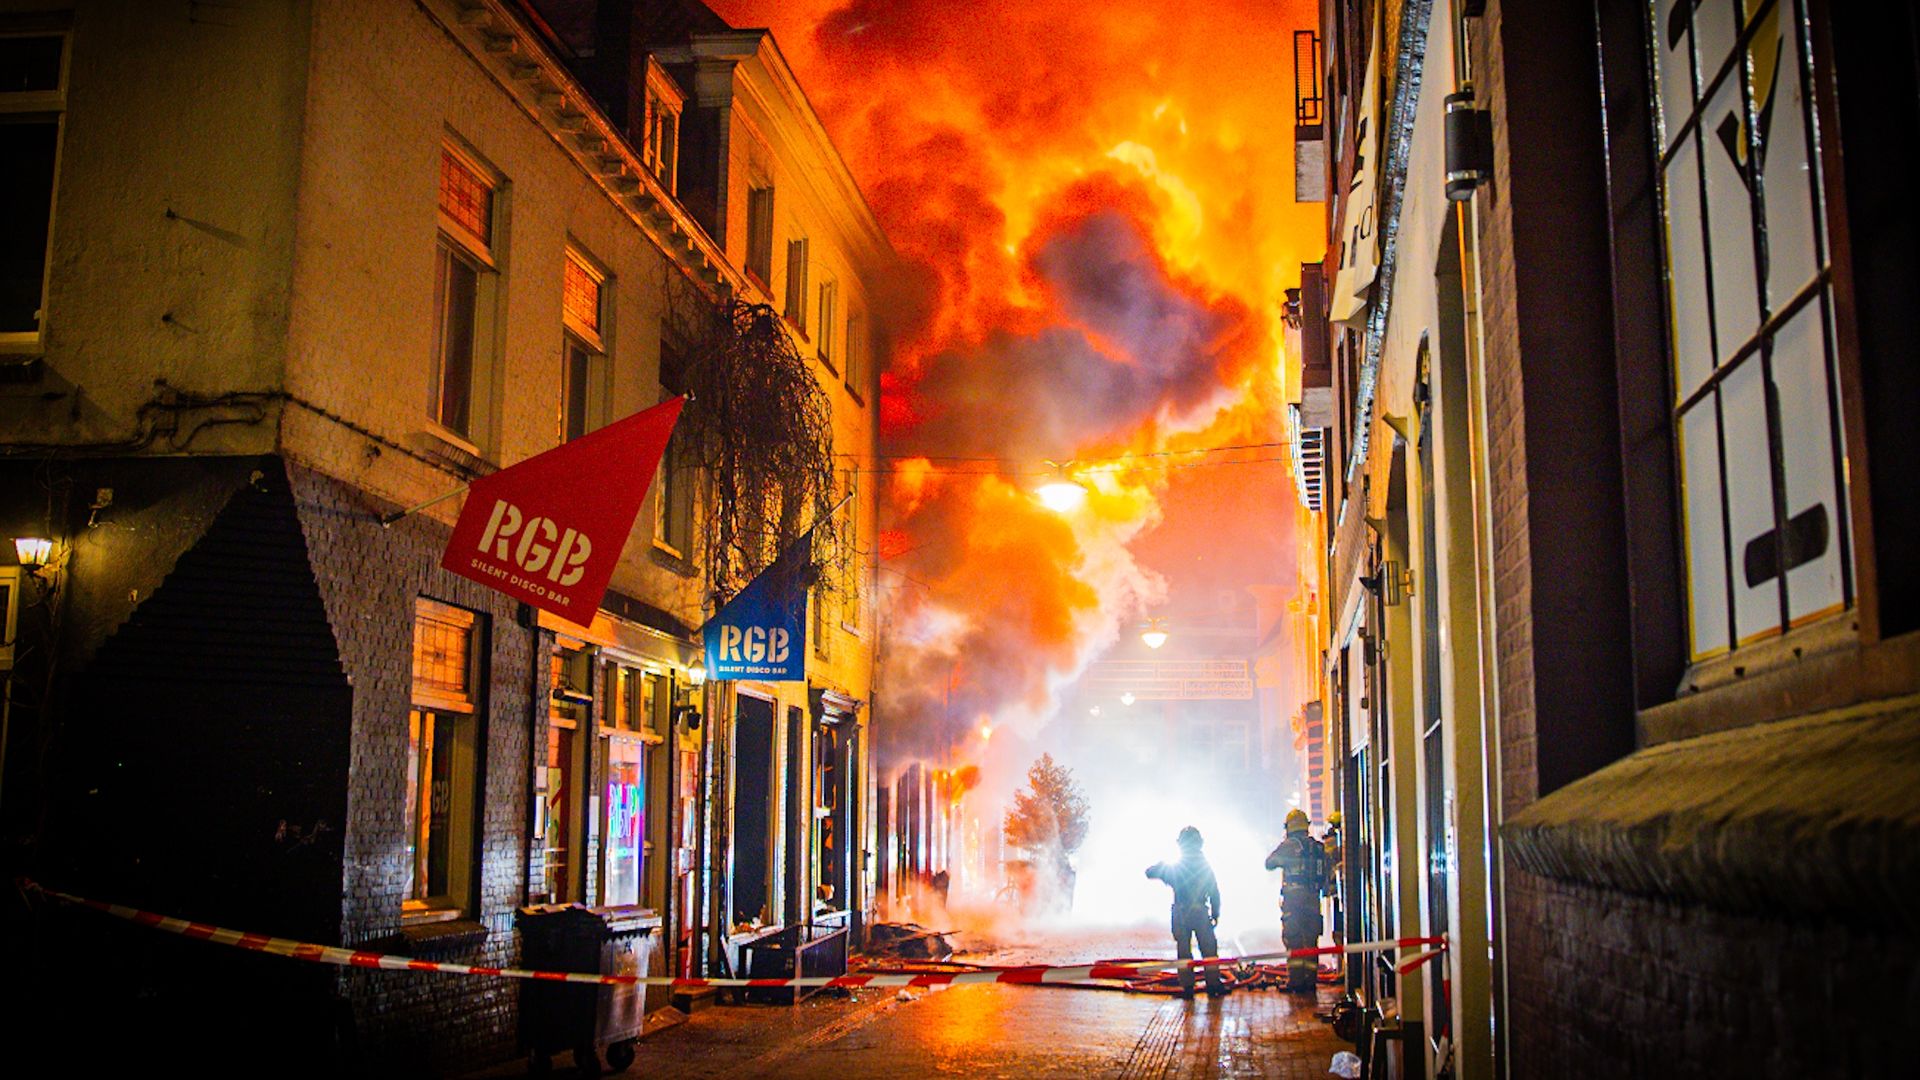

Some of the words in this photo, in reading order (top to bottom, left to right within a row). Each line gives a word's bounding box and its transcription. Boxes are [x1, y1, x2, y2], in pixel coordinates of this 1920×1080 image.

[478, 499, 592, 586] RGB
[471, 559, 509, 580] SILENT
[510, 575, 545, 596] DISCO
[547, 591, 570, 606] BAR
[719, 625, 788, 662] RGB
[747, 666, 770, 674] DISCO
